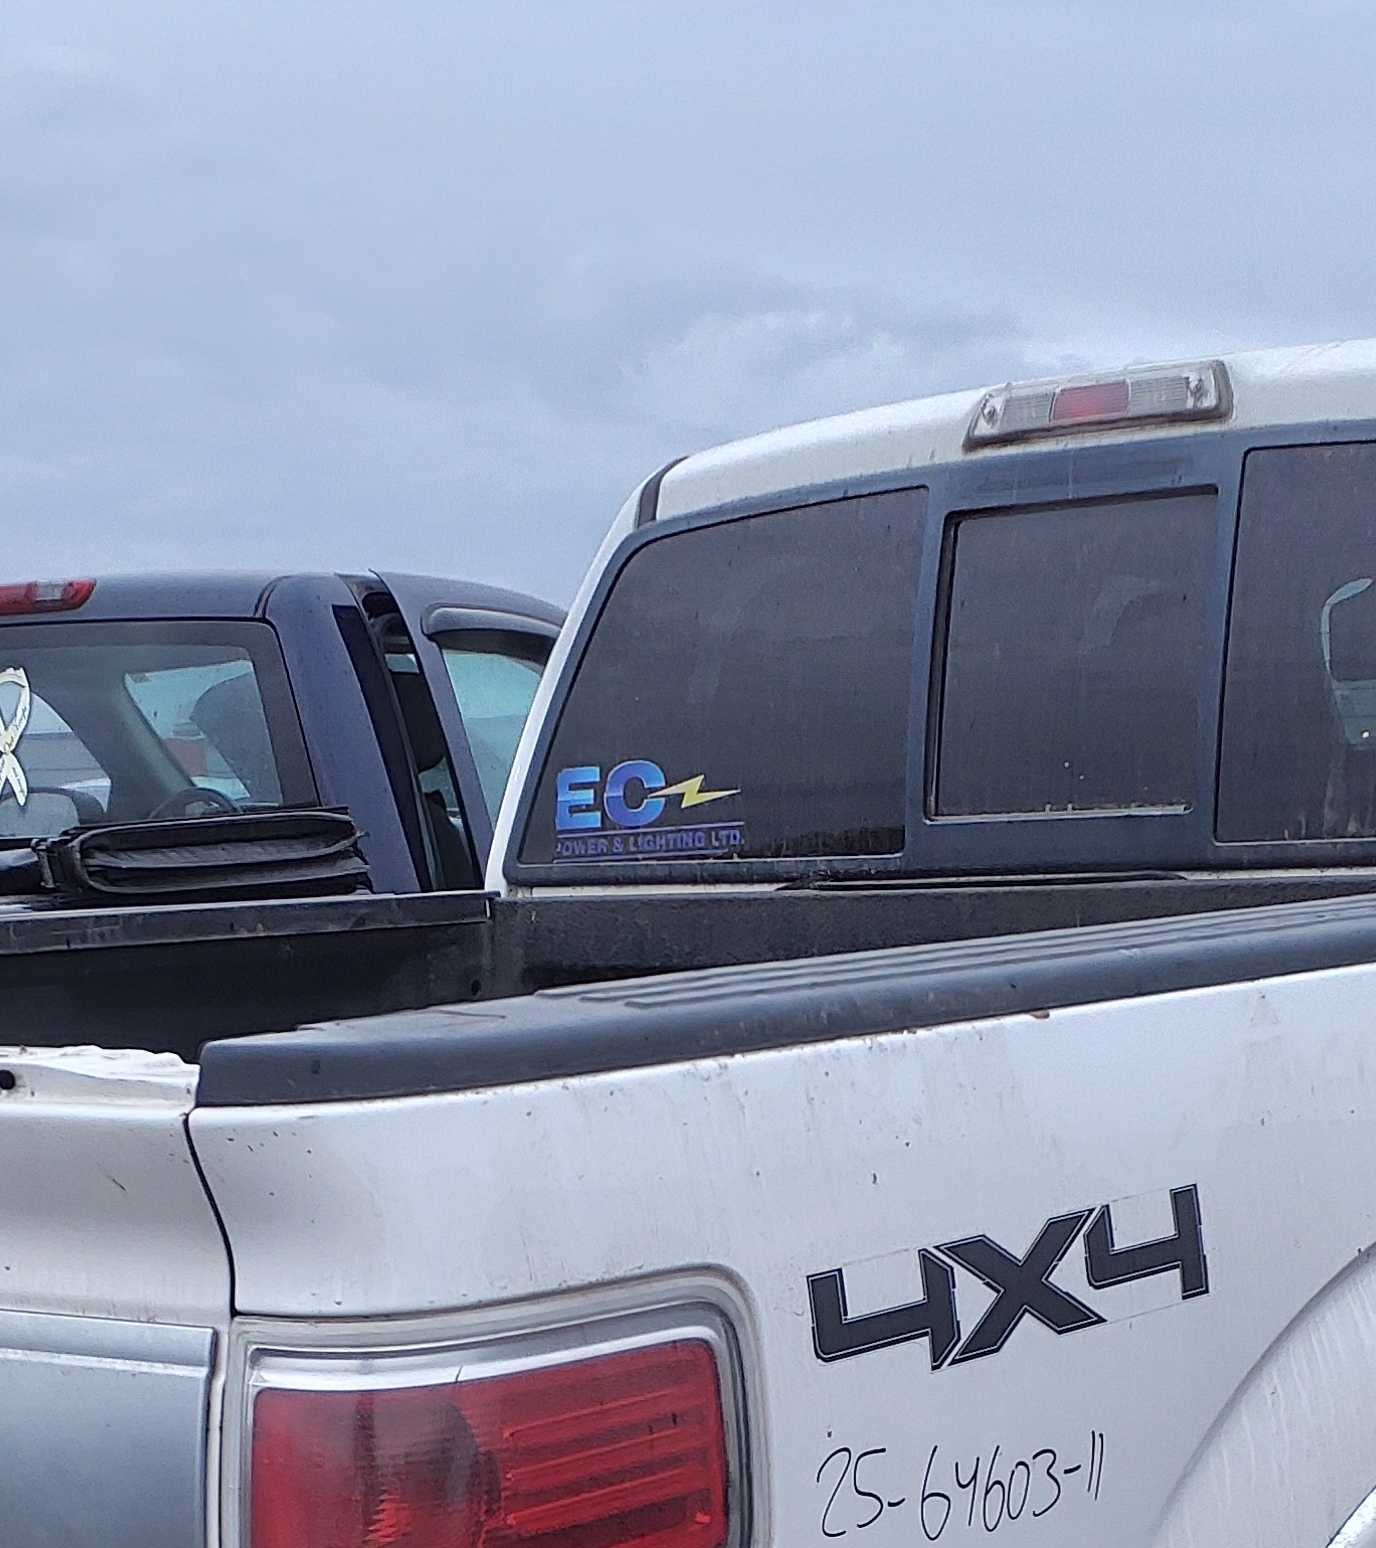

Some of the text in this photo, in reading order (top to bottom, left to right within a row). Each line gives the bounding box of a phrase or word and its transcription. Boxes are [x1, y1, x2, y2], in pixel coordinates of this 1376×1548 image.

[555, 759, 667, 830] EC
[612, 837, 625, 854] &
[628, 830, 706, 852] LIGHTING
[711, 829, 745, 847] LTD.
[806, 1183, 1211, 1372] 4X4
